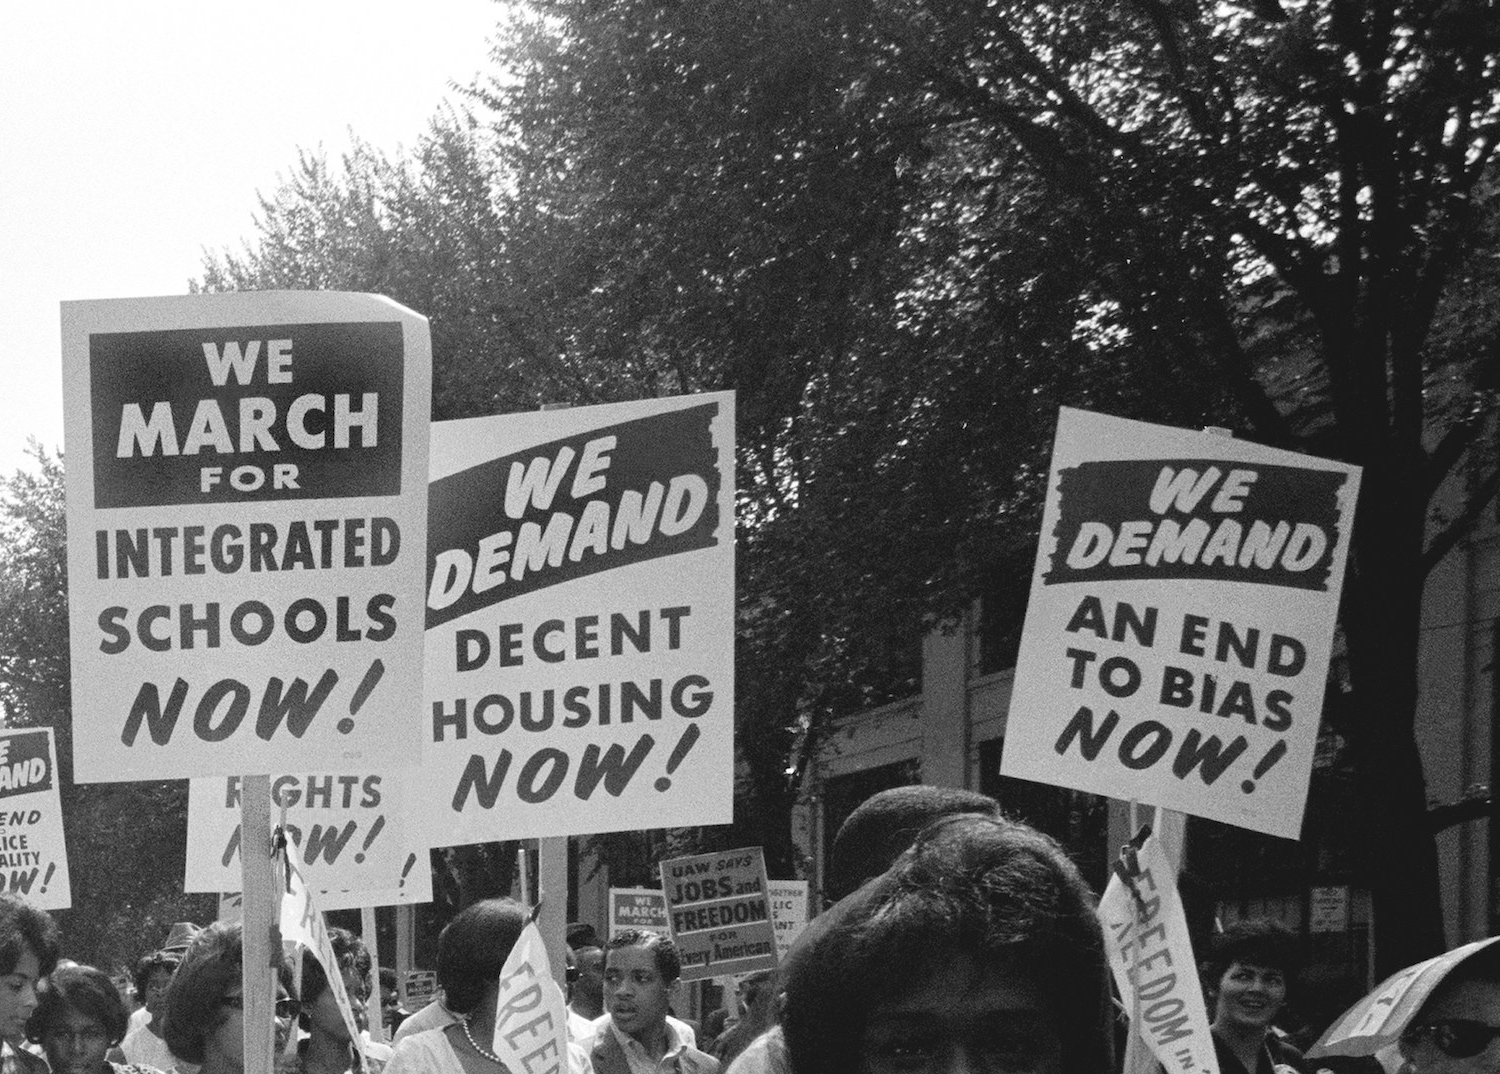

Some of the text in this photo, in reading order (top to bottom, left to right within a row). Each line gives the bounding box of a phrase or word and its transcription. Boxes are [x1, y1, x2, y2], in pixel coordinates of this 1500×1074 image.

[201, 339, 293, 387] WE
[116, 392, 379, 458] MARCH
[200, 463, 301, 493] FOR
[504, 435, 617, 519] WE
[1149, 465, 1258, 515] WE
[95, 517, 401, 580] INTEGRATED
[427, 473, 709, 611] DEMAND
[1066, 518, 1327, 572] DEMAND
[97, 593, 397, 655] SCHOOLS
[455, 605, 692, 672] DECENT
[1064, 594, 1307, 678] AN END
[121, 658, 385, 748] NOW!
[432, 674, 714, 743] HOUSING
[1065, 647, 1294, 733] TO BIAS
[451, 722, 700, 813] NOW!
[1054, 705, 1288, 795] NOW!
[226, 775, 382, 809] RGHTS
[221, 815, 385, 867] W!
[672, 855, 753, 878] UAW SAYS
[618, 906, 667, 918] MARCH
[670, 876, 761, 904] JOBS and
[673, 899, 767, 933] FREEDOM
[709, 931, 738, 942] FOR
[714, 941, 771, 960] American
[1130, 867, 1194, 1046] FREEDOM
[1175, 1048, 1195, 1071] IN
